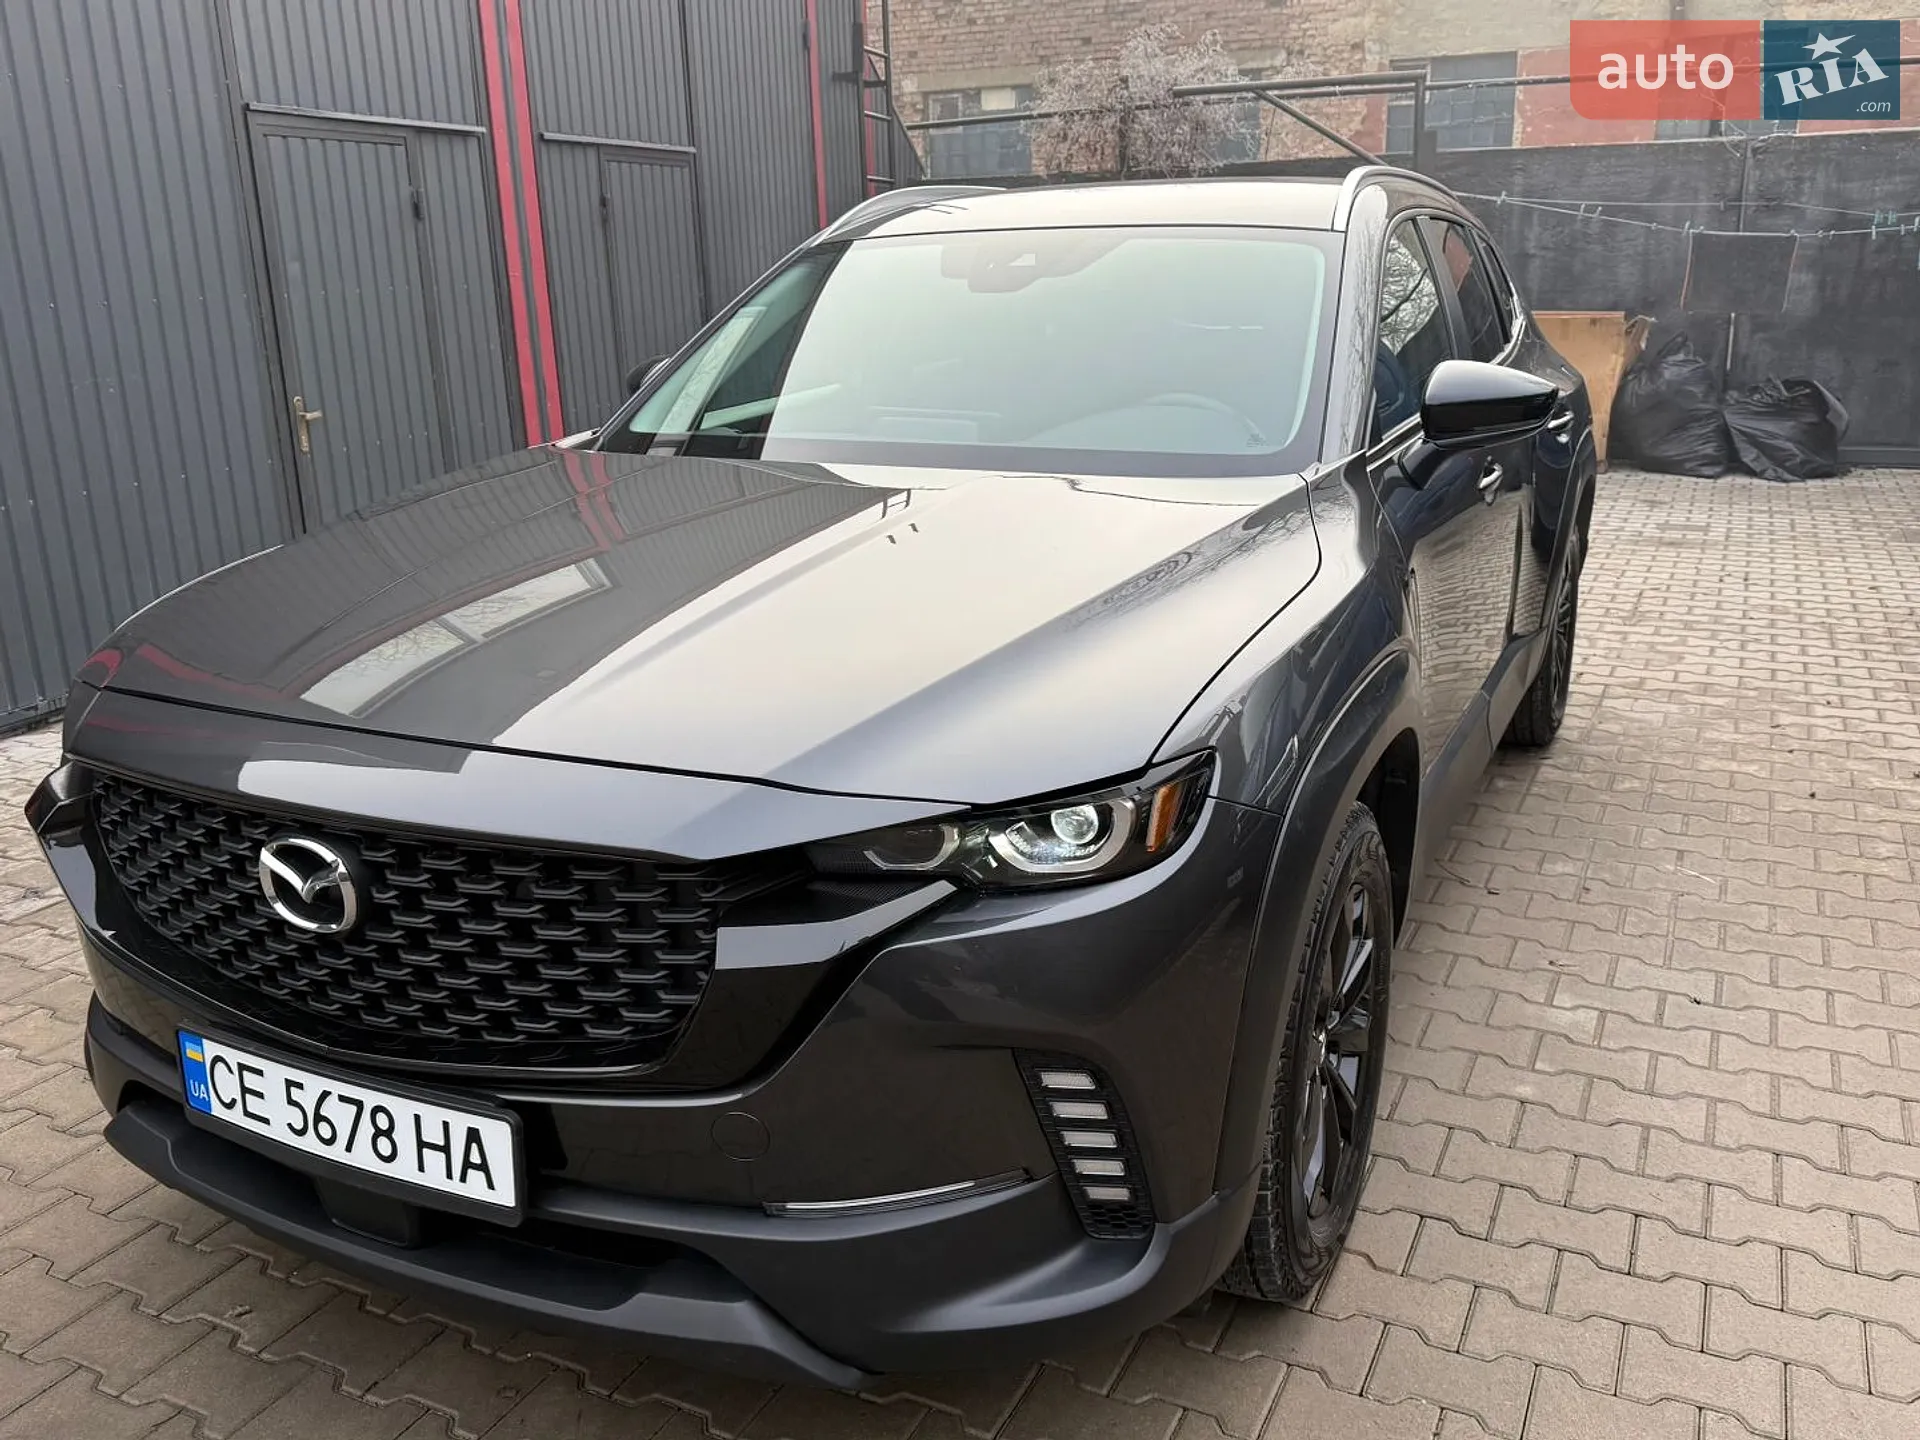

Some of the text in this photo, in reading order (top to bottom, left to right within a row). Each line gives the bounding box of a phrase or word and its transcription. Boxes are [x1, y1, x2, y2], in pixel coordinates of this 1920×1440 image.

[190, 1079, 209, 1101] UA
[209, 1055, 495, 1190] CE 5678 HA
